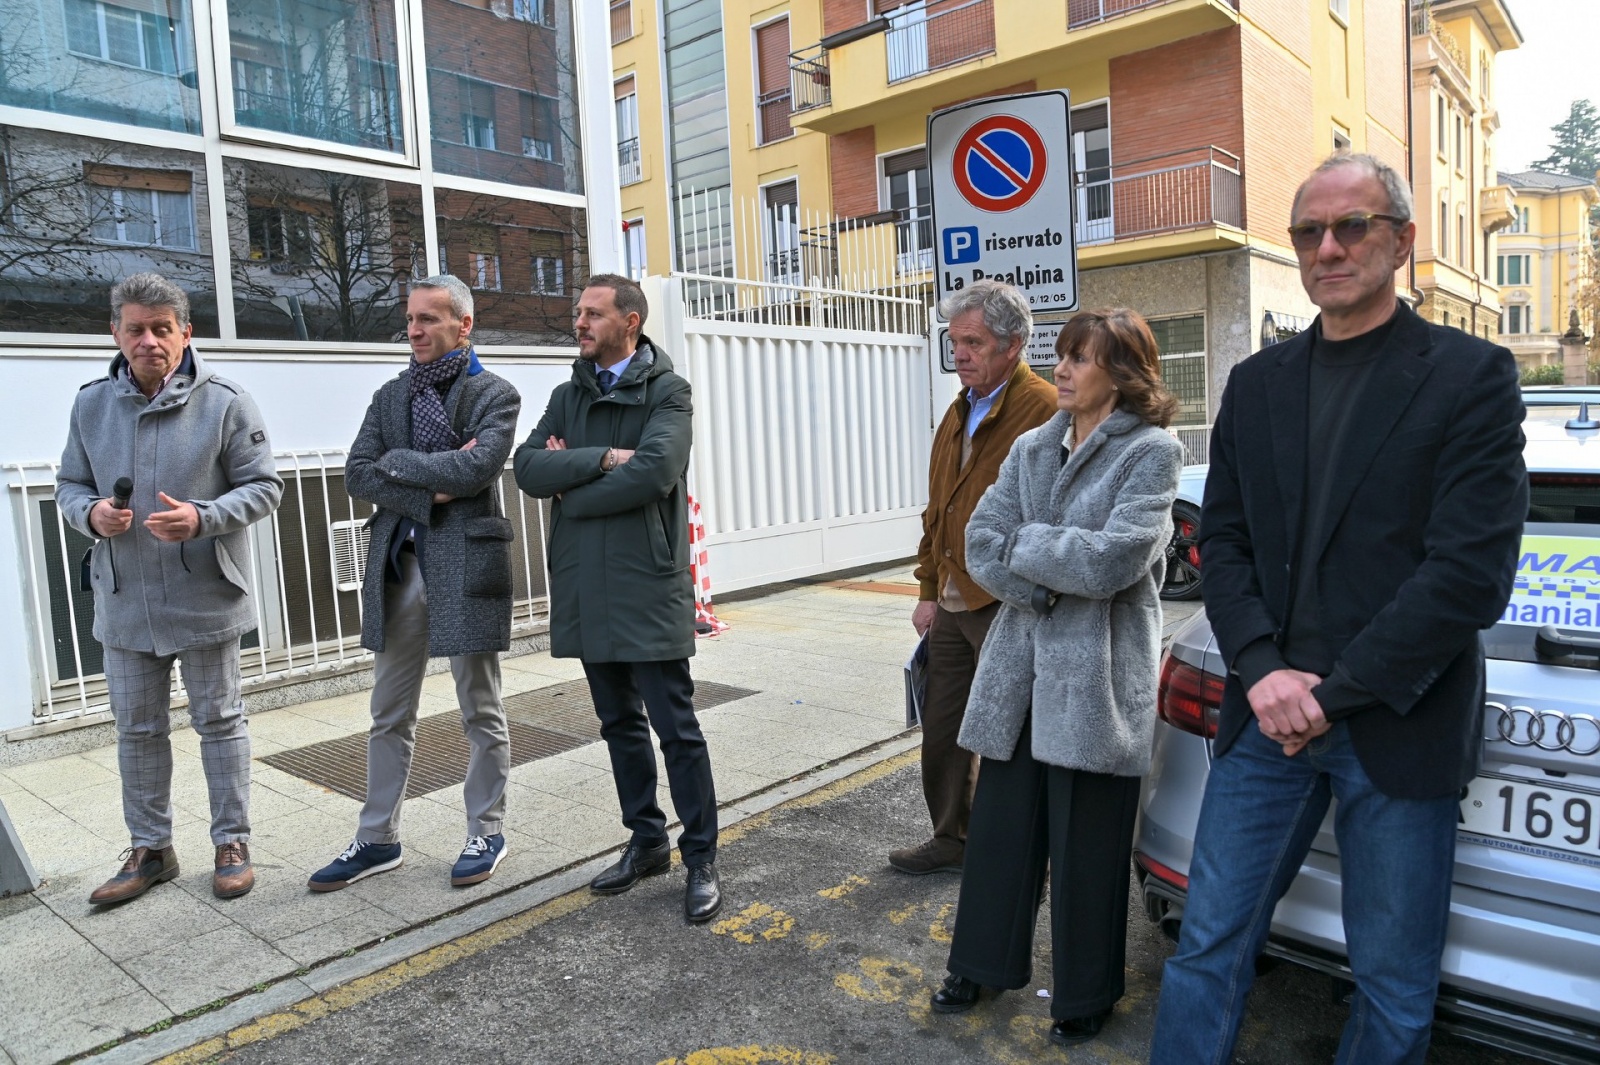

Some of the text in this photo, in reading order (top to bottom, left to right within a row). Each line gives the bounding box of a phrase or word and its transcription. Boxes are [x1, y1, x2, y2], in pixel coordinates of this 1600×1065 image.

[950, 227, 1063, 260] P riservato
[945, 271, 965, 291] La
[1038, 332, 1049, 340] per
[1499, 785, 1600, 846] 169
